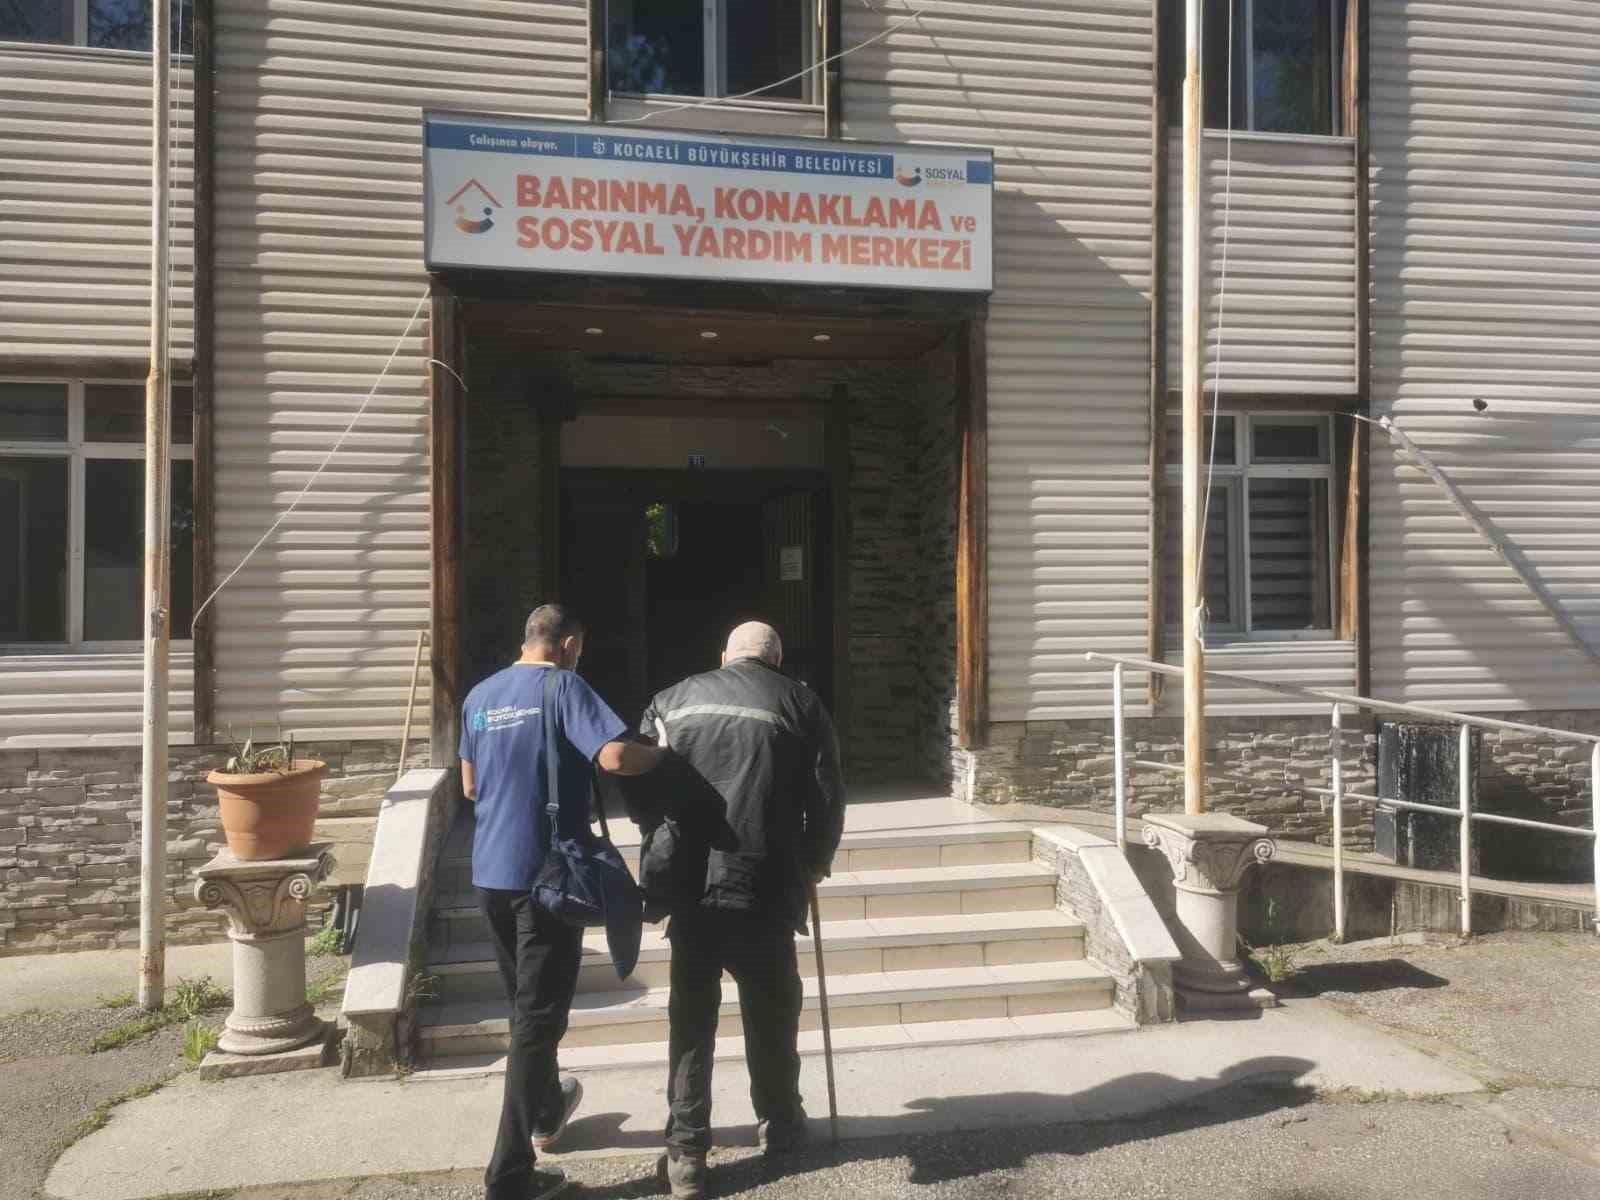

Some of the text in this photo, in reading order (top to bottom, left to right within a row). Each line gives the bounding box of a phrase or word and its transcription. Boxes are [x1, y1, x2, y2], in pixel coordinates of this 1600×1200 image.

[613, 142, 883, 175] KOCAELİ BÜYÜKŞEHİR BELEDİYESİ
[925, 167, 966, 181] SOSYAL
[516, 174, 977, 232] BARINMA, KONAKLAMA ve
[516, 215, 973, 271] SOSYAL YARDIM MERKEZİ
